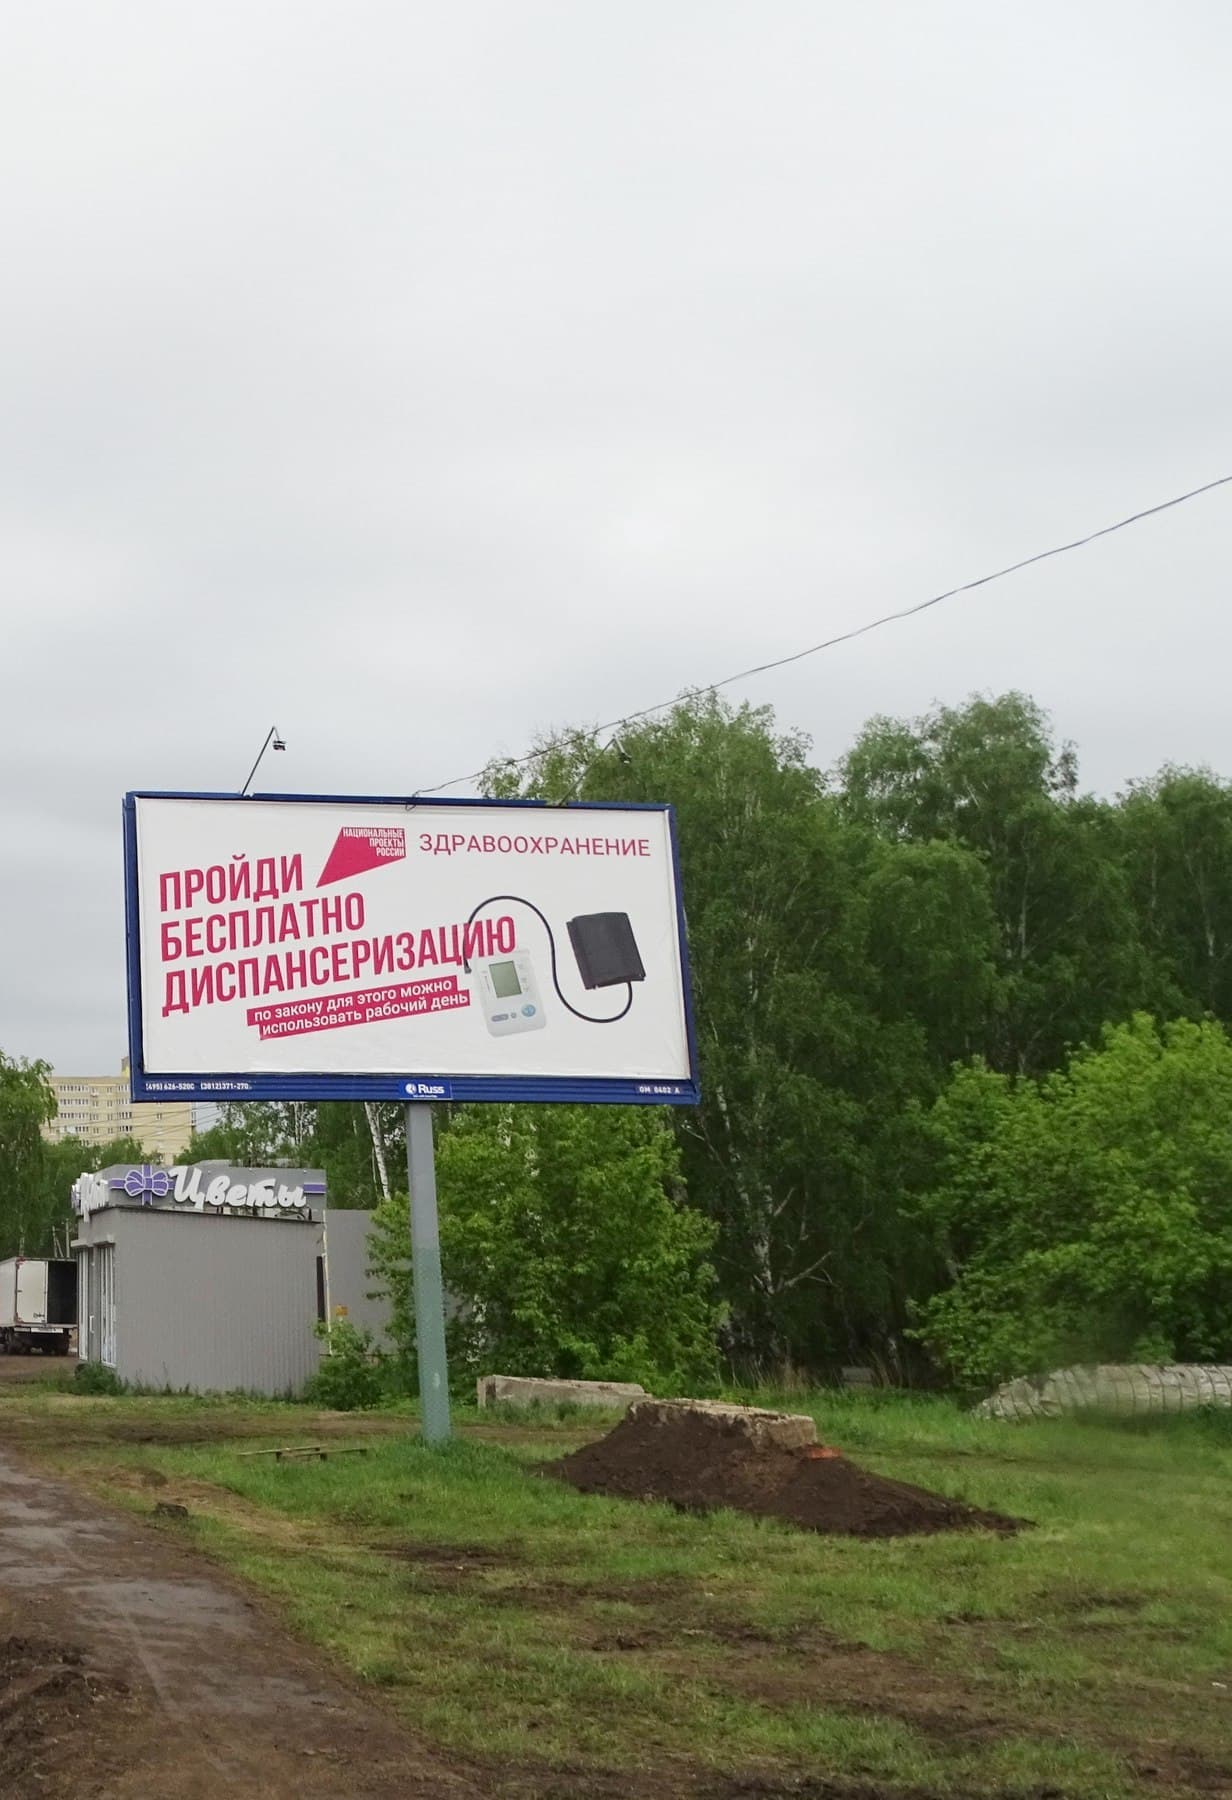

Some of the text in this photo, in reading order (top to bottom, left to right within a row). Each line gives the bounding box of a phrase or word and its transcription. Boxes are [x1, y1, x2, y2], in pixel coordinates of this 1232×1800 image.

[342, 828, 403, 839] НАЦИОНАЛЬНЫЕ
[369, 838, 404, 848] ПРОЕКТЫ
[376, 847, 405, 857] РОССИИ
[419, 834, 651, 857] ЗДРАВООХРАНЕНИЕ
[159, 853, 303, 912] ПРОЙДИ
[161, 892, 365, 962] БЕСПЛАТНО
[162, 915, 516, 1018] ДИСПАНСЕРИЗАЦИЮ
[254, 980, 452, 1022] по закону для этого можно
[262, 993, 468, 1036] использовать рабочий день
[418, 1084, 445, 1094] Russ
[167, 1166, 307, 1211] Цветы
